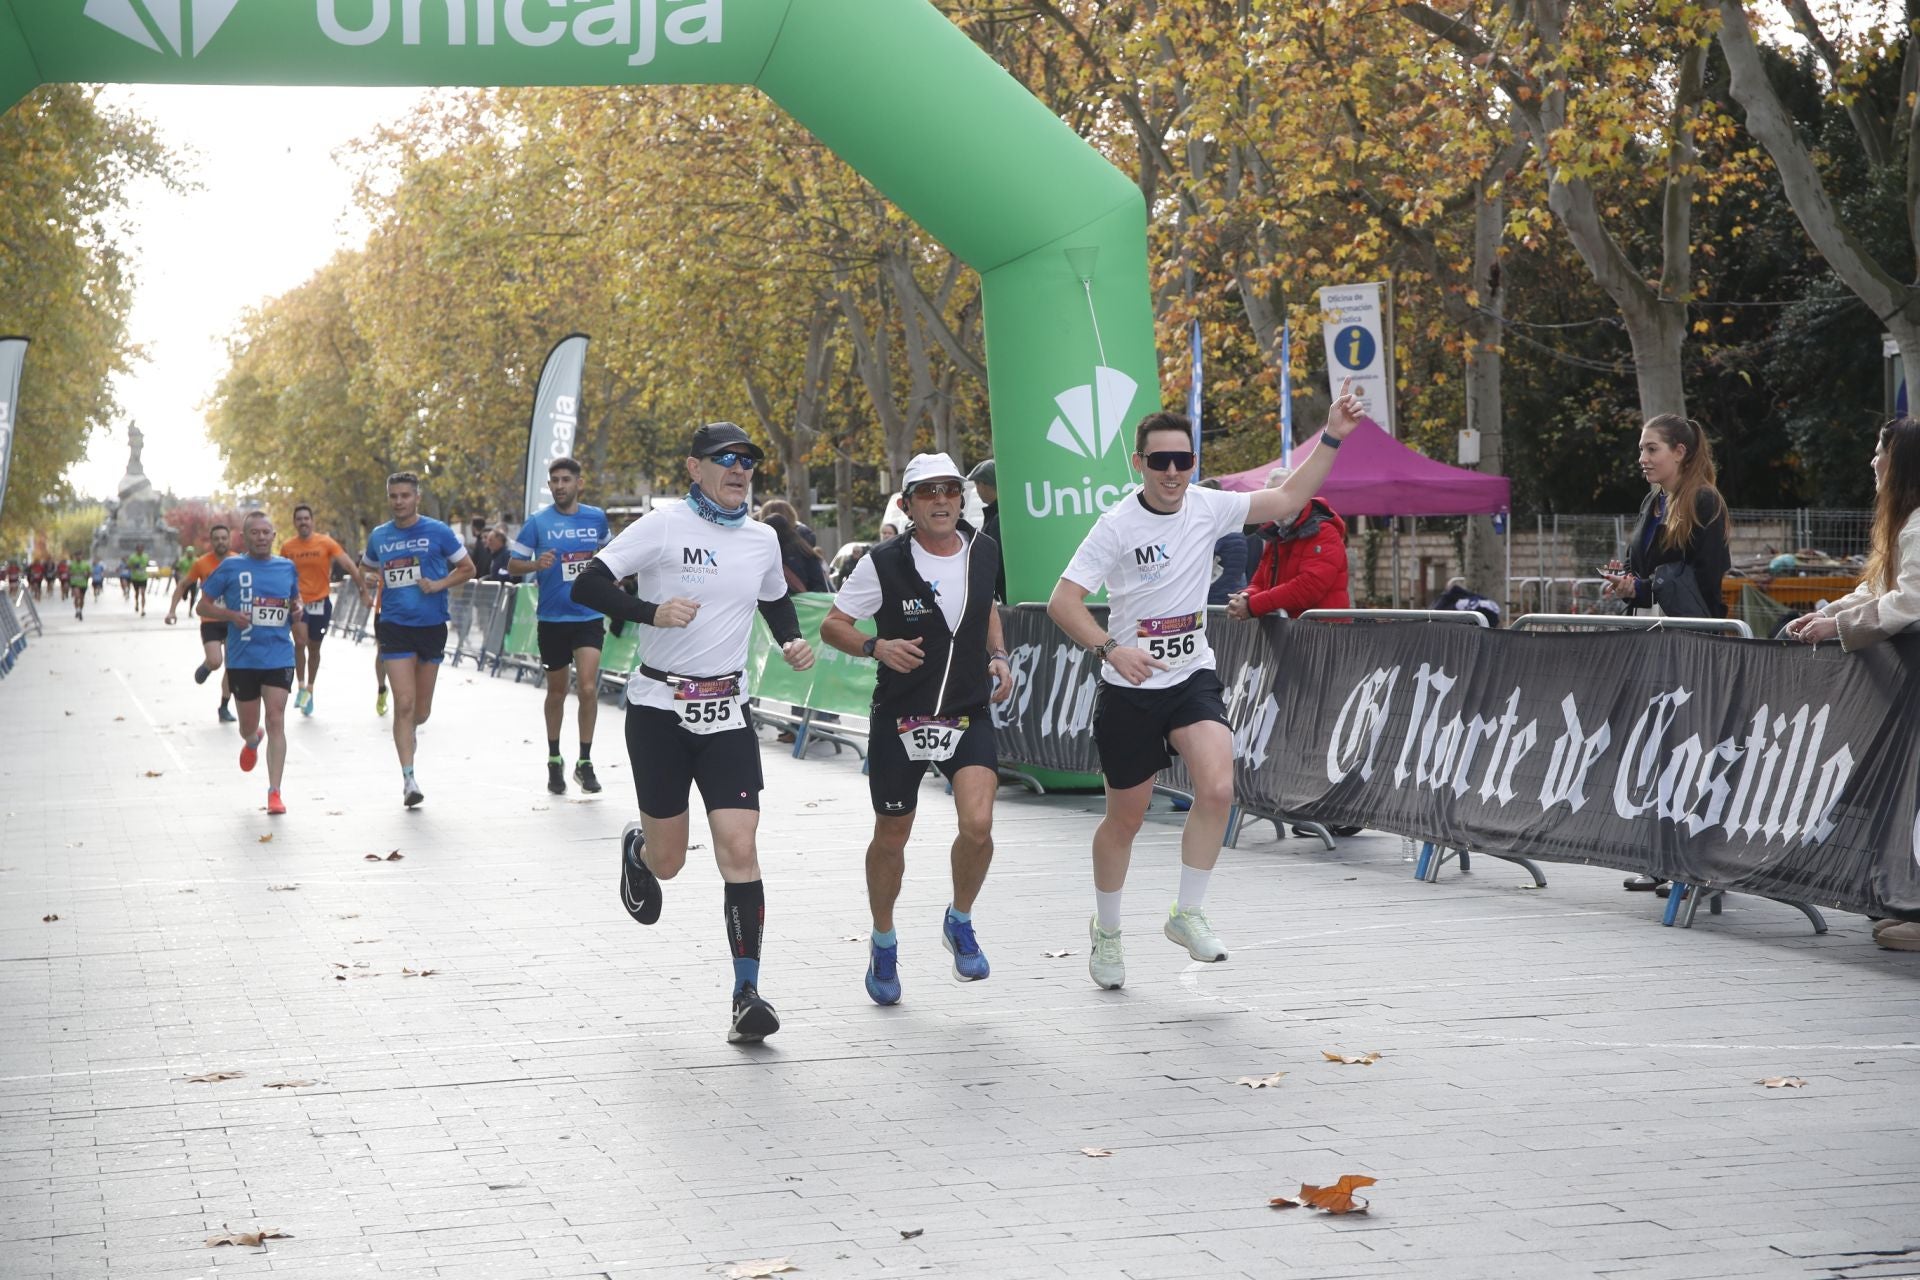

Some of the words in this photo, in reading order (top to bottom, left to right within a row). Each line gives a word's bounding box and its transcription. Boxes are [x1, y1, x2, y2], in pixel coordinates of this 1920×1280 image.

[316, 0, 722, 66] Unicaja
[1329, 304, 1373, 313] rmación
[547, 527, 598, 541] IVECO
[379, 538, 430, 554] IVECO
[683, 547, 718, 567] MX
[1135, 544, 1170, 565] MX
[389, 568, 413, 582] 571
[681, 566, 718, 576] INDUSTRIAS
[681, 575, 705, 584] MAXI
[902, 598, 925, 611] MX
[259, 608, 284, 621] 570
[1149, 634, 1195, 660] 556
[684, 699, 731, 724] 555
[912, 728, 953, 751] 554
[1327, 664, 1400, 785] El
[1393, 662, 1537, 809] Norte
[1537, 692, 1611, 814] de
